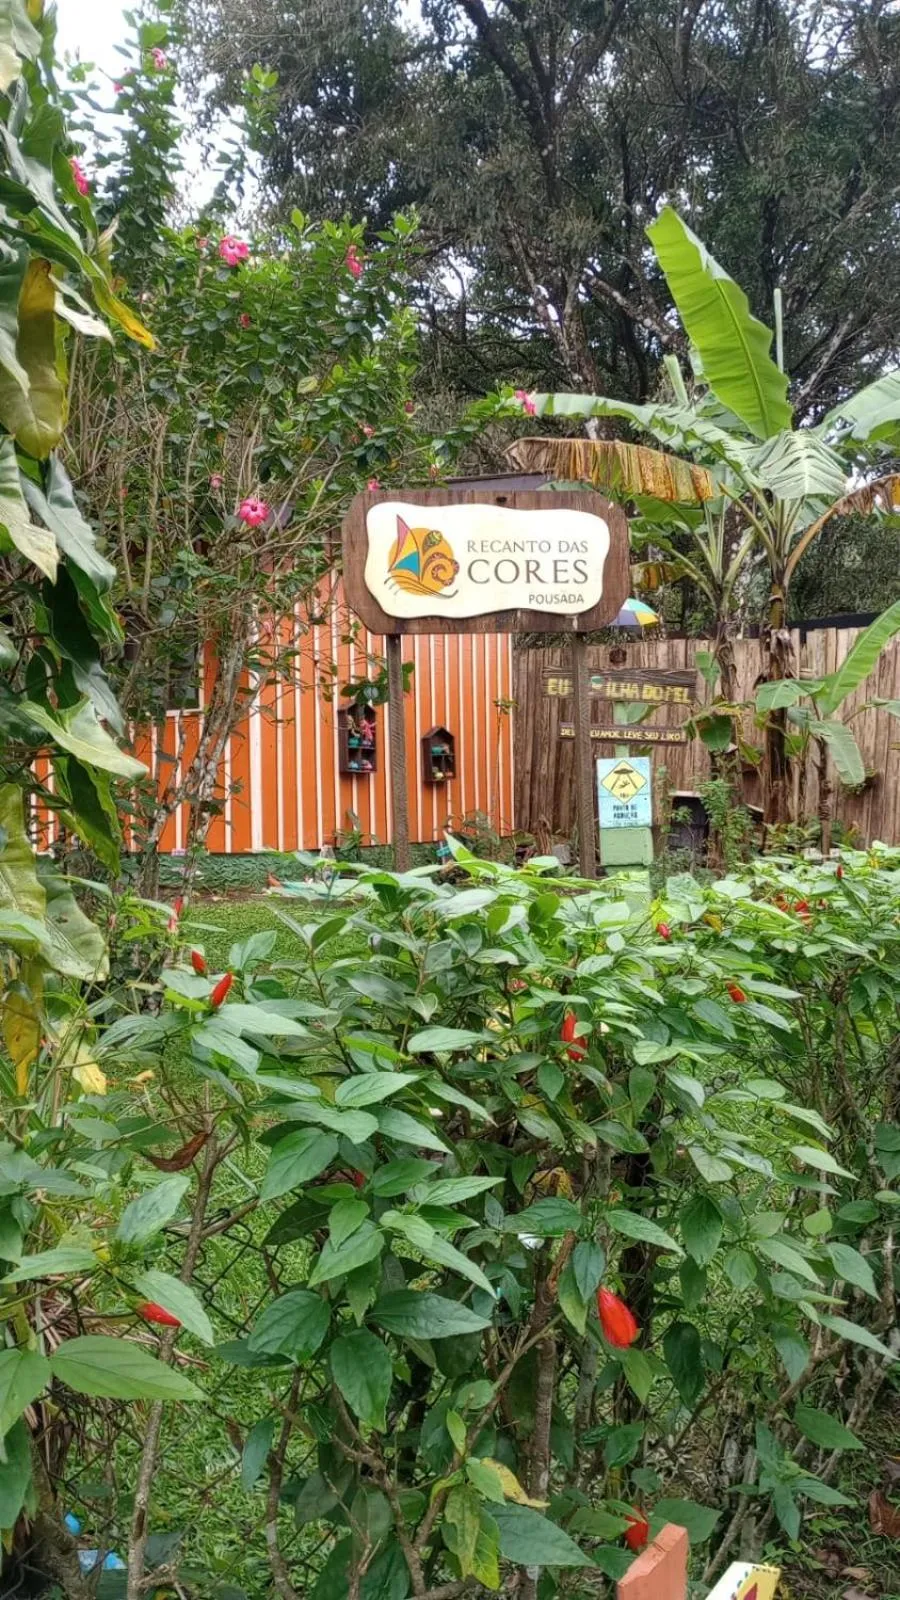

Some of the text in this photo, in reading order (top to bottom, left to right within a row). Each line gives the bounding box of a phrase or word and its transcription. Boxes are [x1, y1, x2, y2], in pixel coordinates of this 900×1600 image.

[467, 540, 588, 553] RECANTO DAS
[467, 559, 588, 585] CORES
[528, 593, 584, 605] POUSADA
[547, 678, 569, 695] EU
[605, 681, 640, 699] ILHA
[642, 684, 663, 700] DO
[623, 730, 644, 740] LEVE
